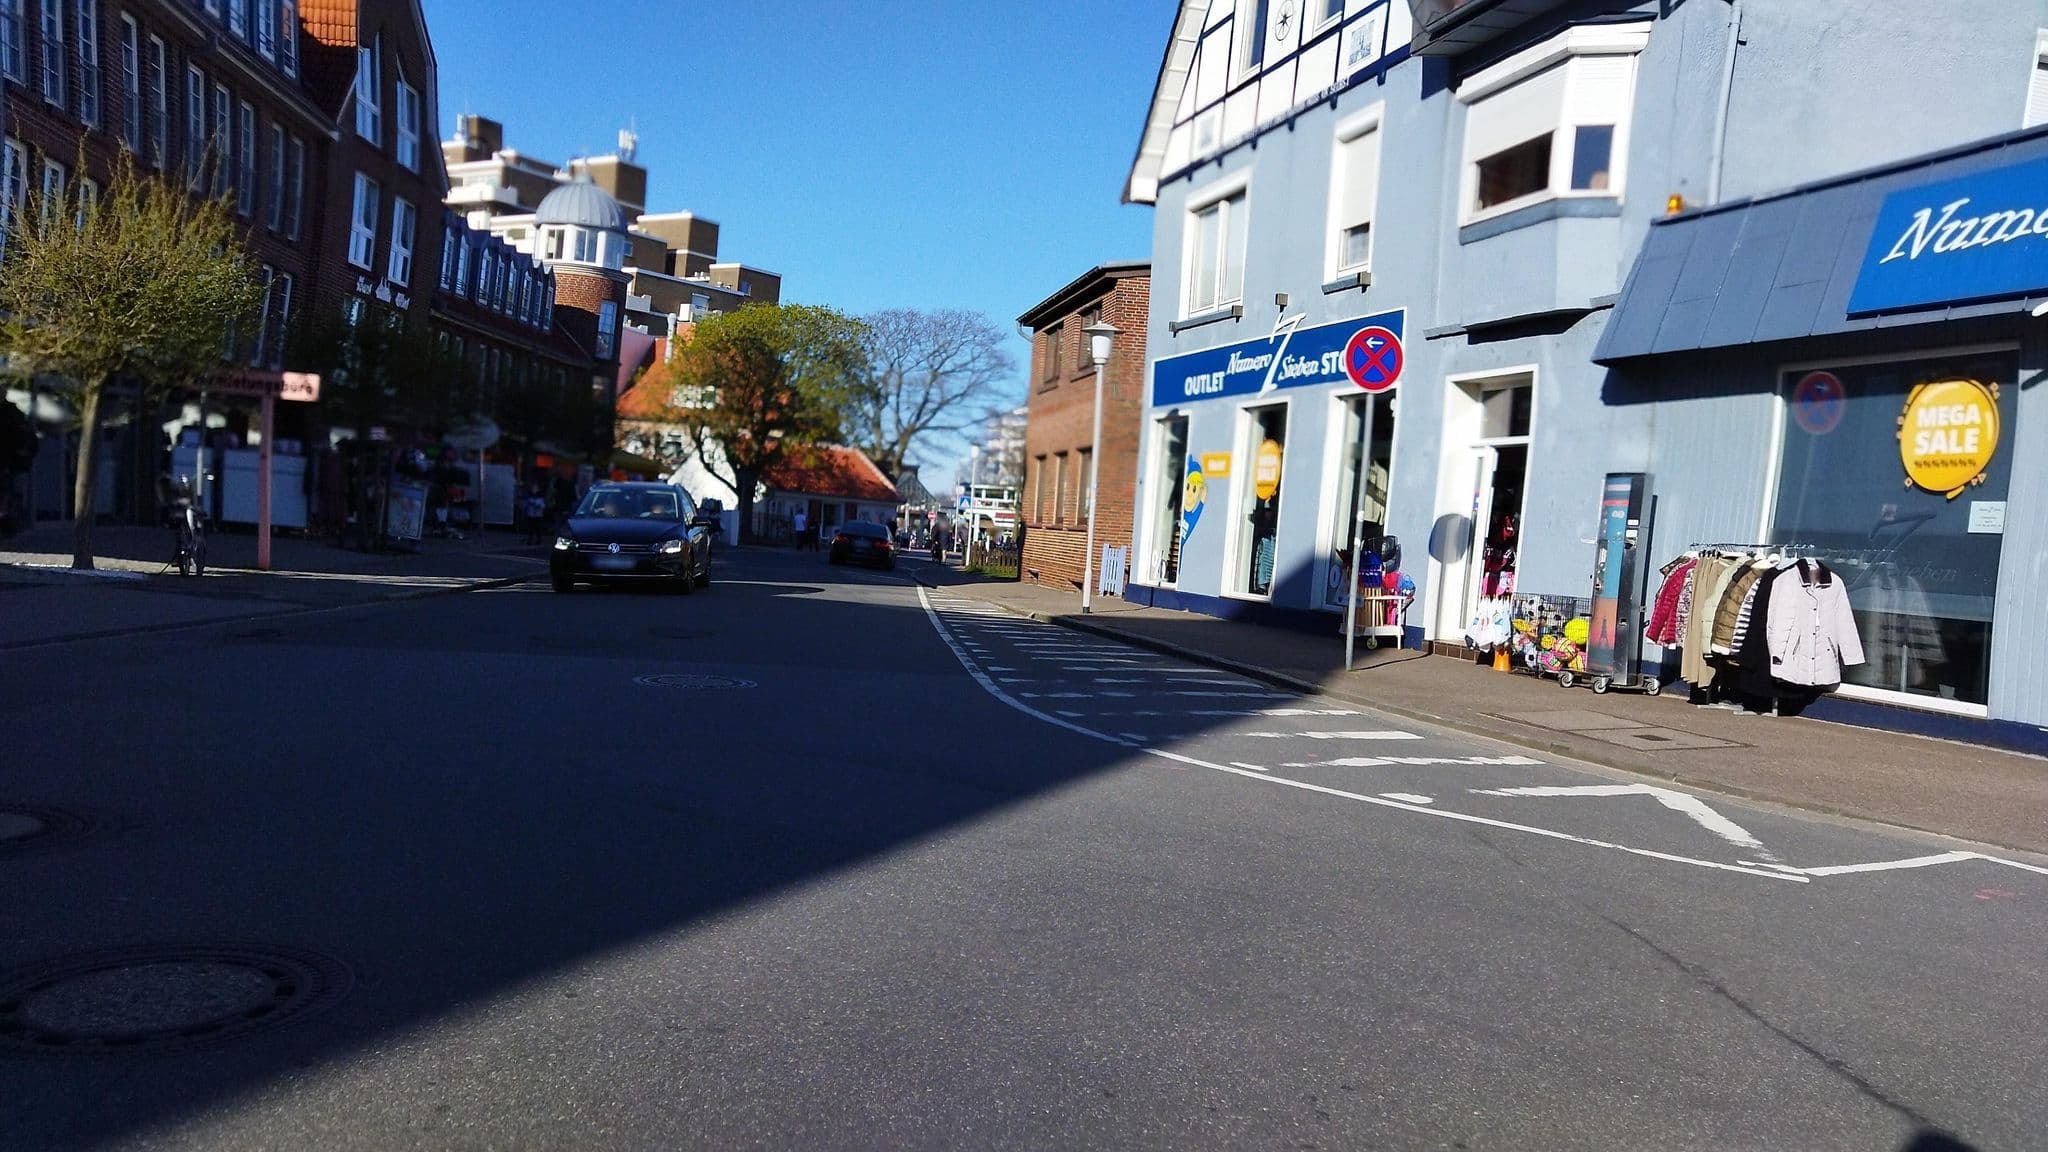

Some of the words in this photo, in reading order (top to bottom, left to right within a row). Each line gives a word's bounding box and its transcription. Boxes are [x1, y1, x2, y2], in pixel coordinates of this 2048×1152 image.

[1879, 197, 2048, 265] Nume
[1184, 371, 1226, 396] OUTLET
[1226, 351, 1273, 375] Numero
[1278, 353, 1320, 381] Sieben
[1321, 350, 1346, 376] STO
[1917, 403, 1981, 428] MEGA
[1914, 428, 1980, 456] SALE
